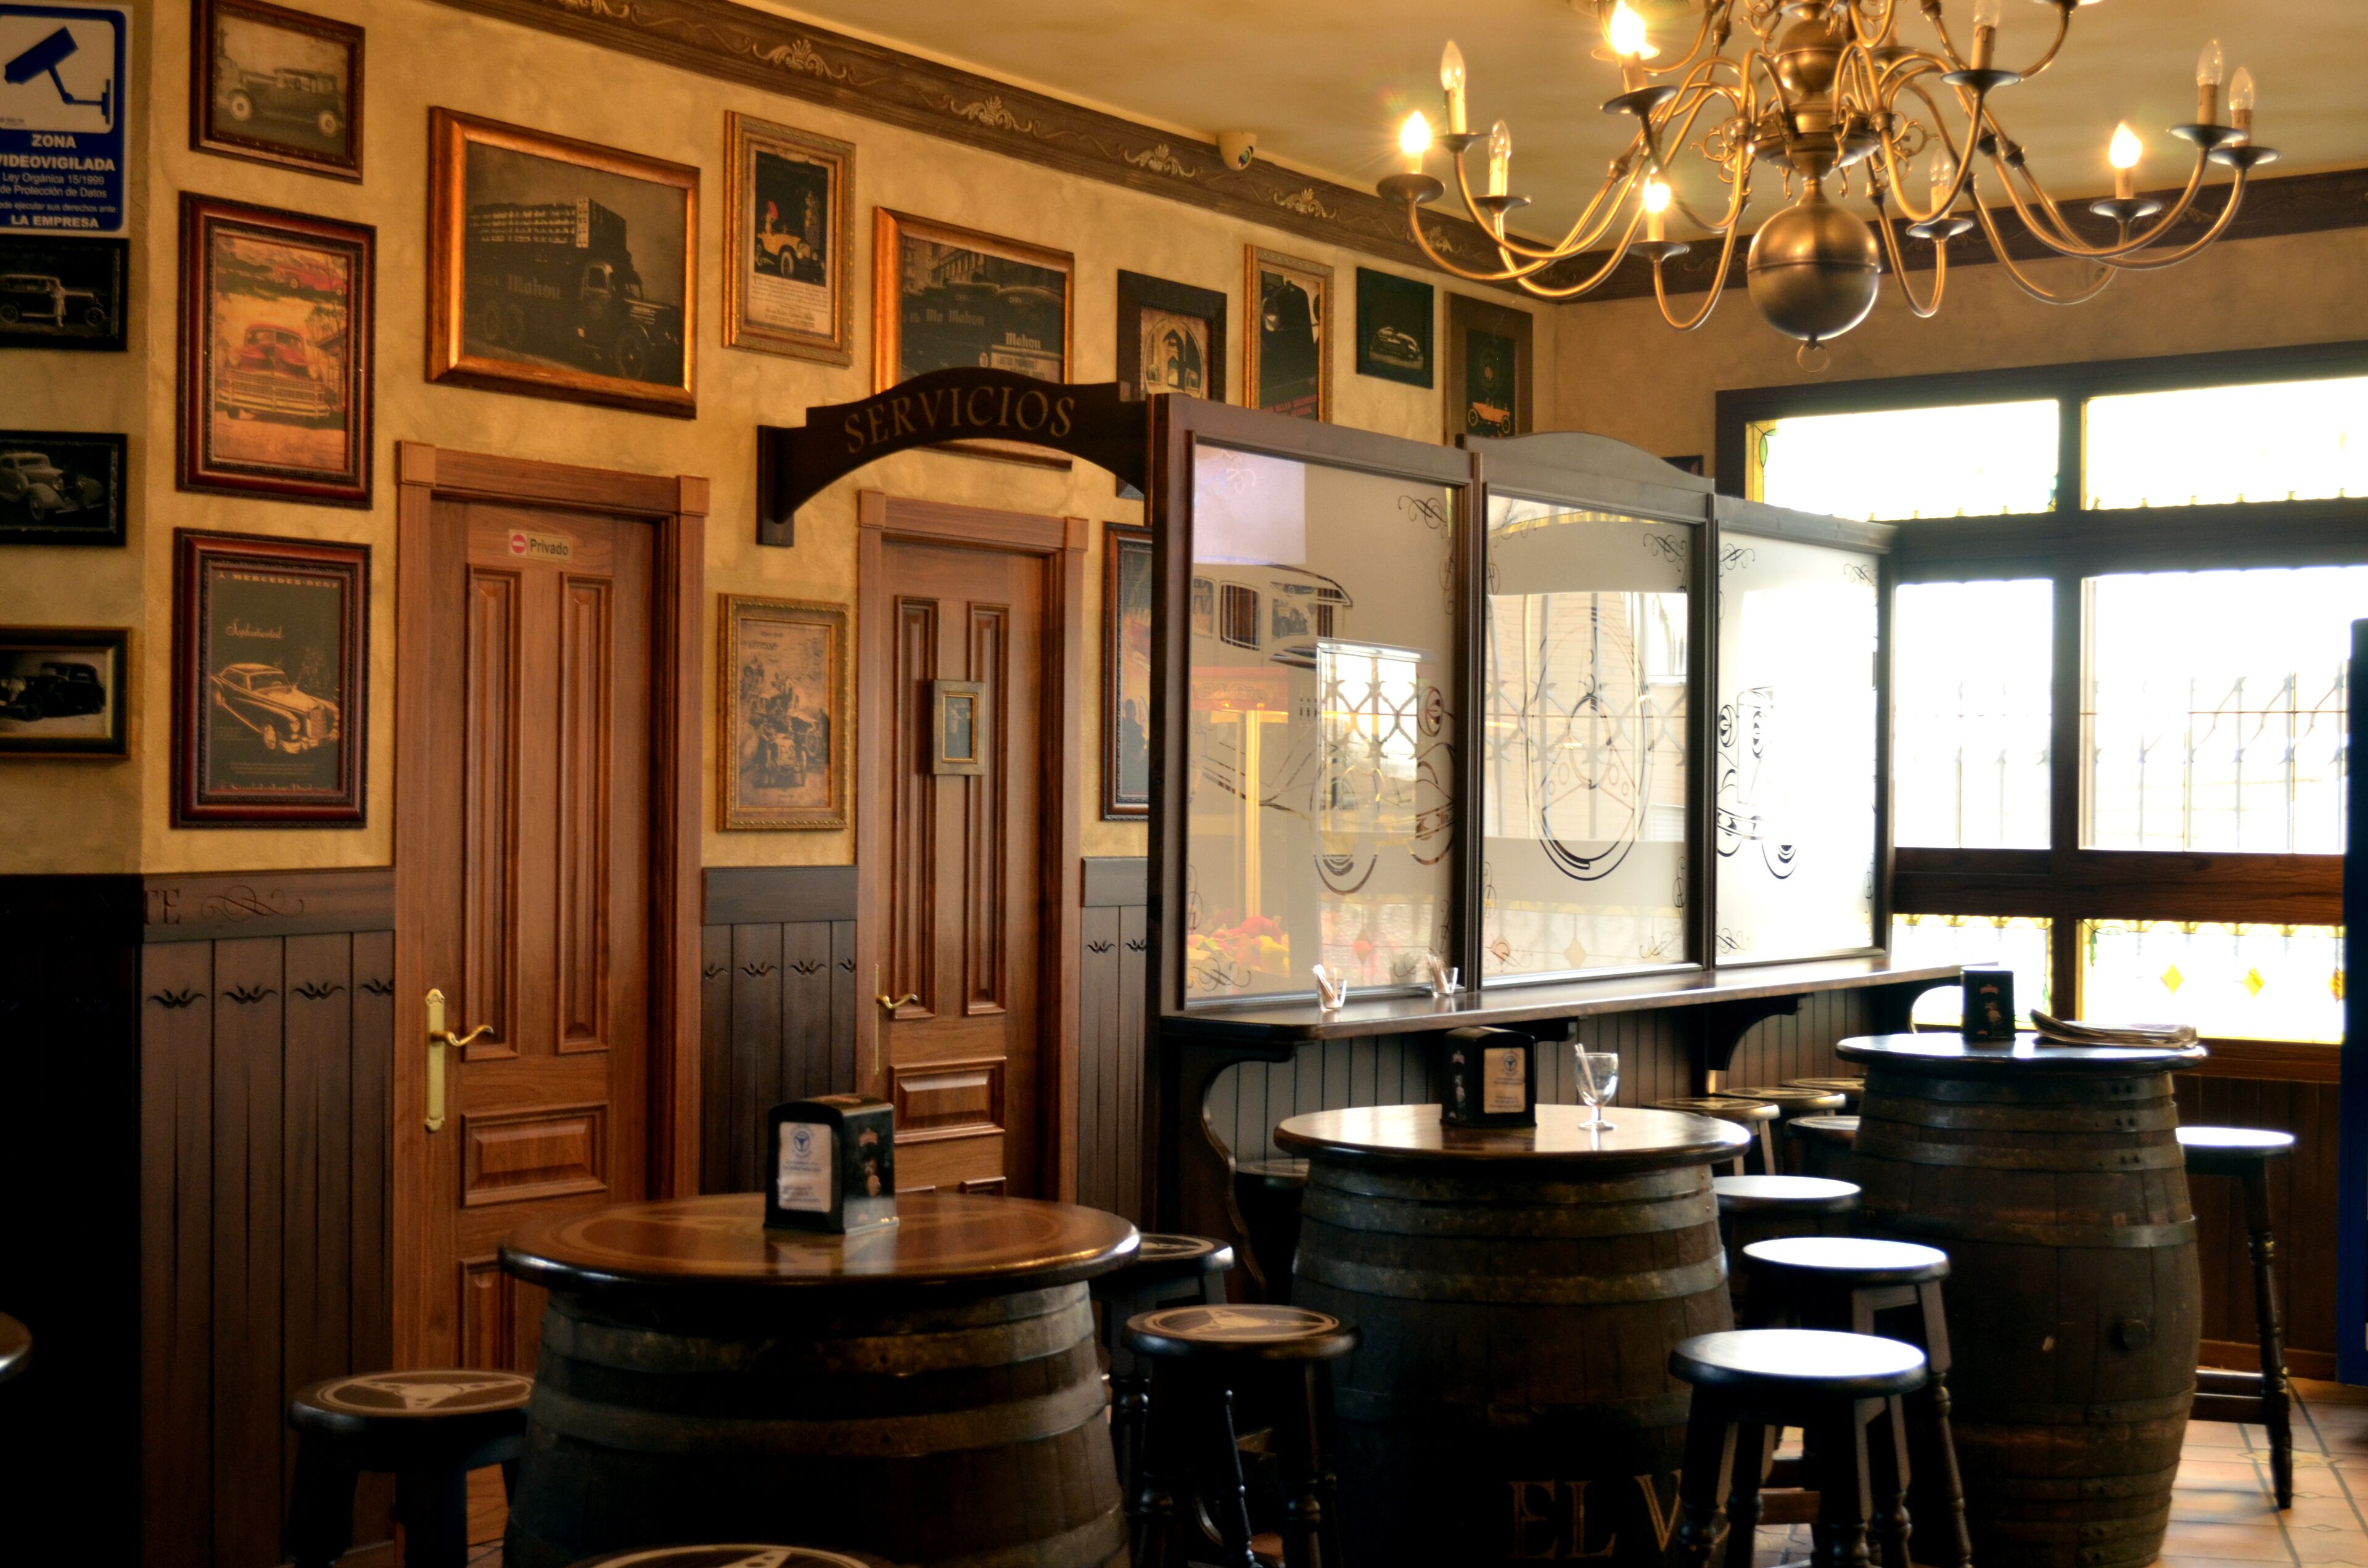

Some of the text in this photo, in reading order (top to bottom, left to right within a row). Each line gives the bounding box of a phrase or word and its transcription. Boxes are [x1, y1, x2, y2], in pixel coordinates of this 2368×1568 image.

[31, 134, 76, 149] ZONA
[2, 172, 105, 186] Ley Orgánica 15/1999
[14, 185, 63, 197] Protección
[65, 187, 78, 197] de
[80, 187, 107, 199] Datos
[11, 215, 99, 229] LA EMPRESA
[844, 387, 1075, 454] SERVICIOS
[530, 538, 569, 556] Privado
[1508, 1479, 1617, 1560] EL
